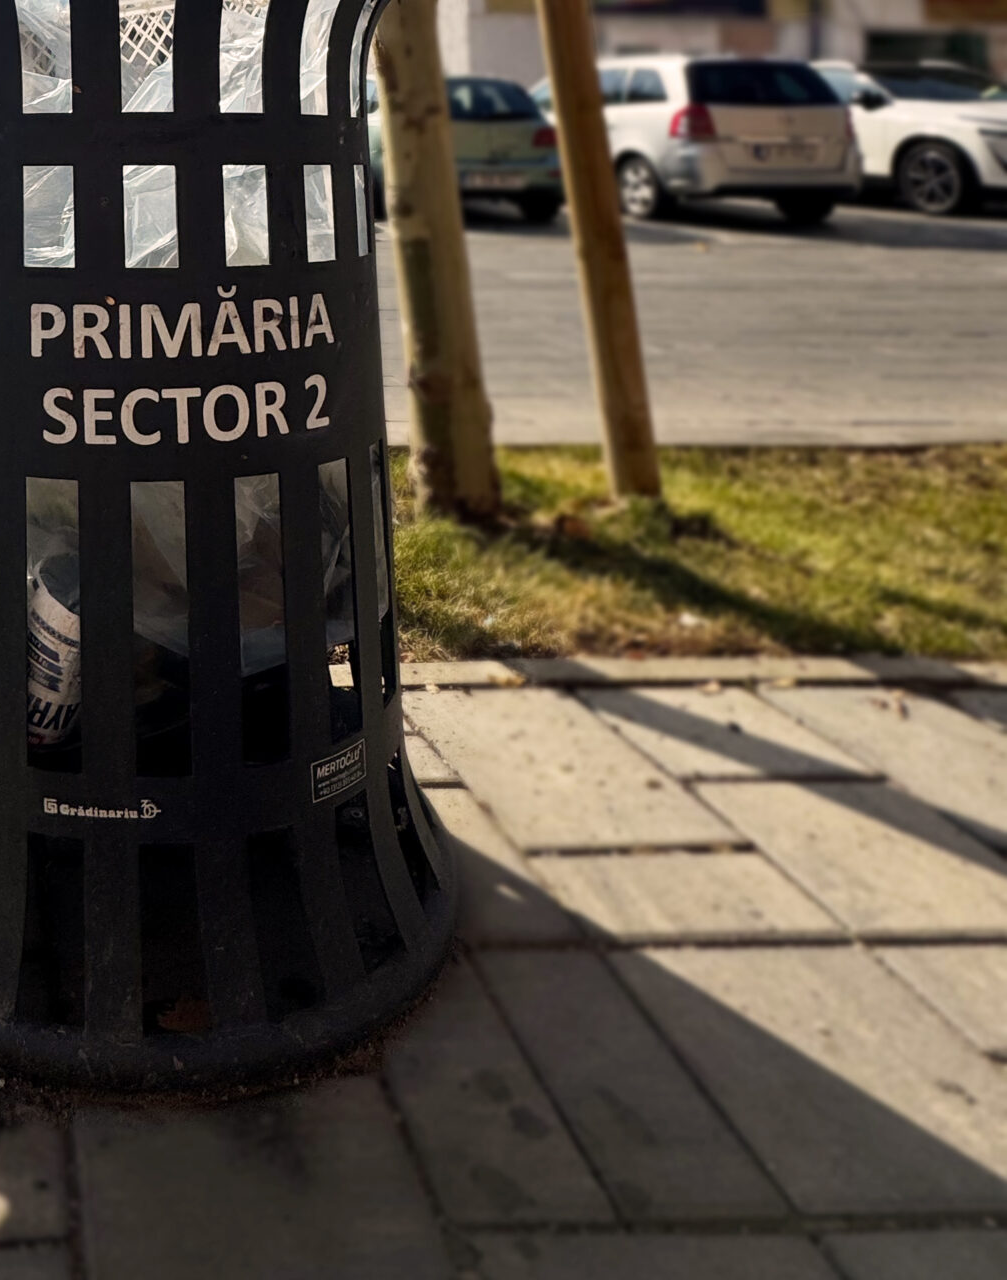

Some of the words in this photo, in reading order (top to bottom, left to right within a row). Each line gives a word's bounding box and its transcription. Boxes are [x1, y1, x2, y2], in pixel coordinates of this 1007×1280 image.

[30, 284, 335, 359] PRIMĂRIA
[42, 380, 290, 446] SECTOR
[304, 373, 330, 430] 2
[27, 695, 80, 730] AYR
